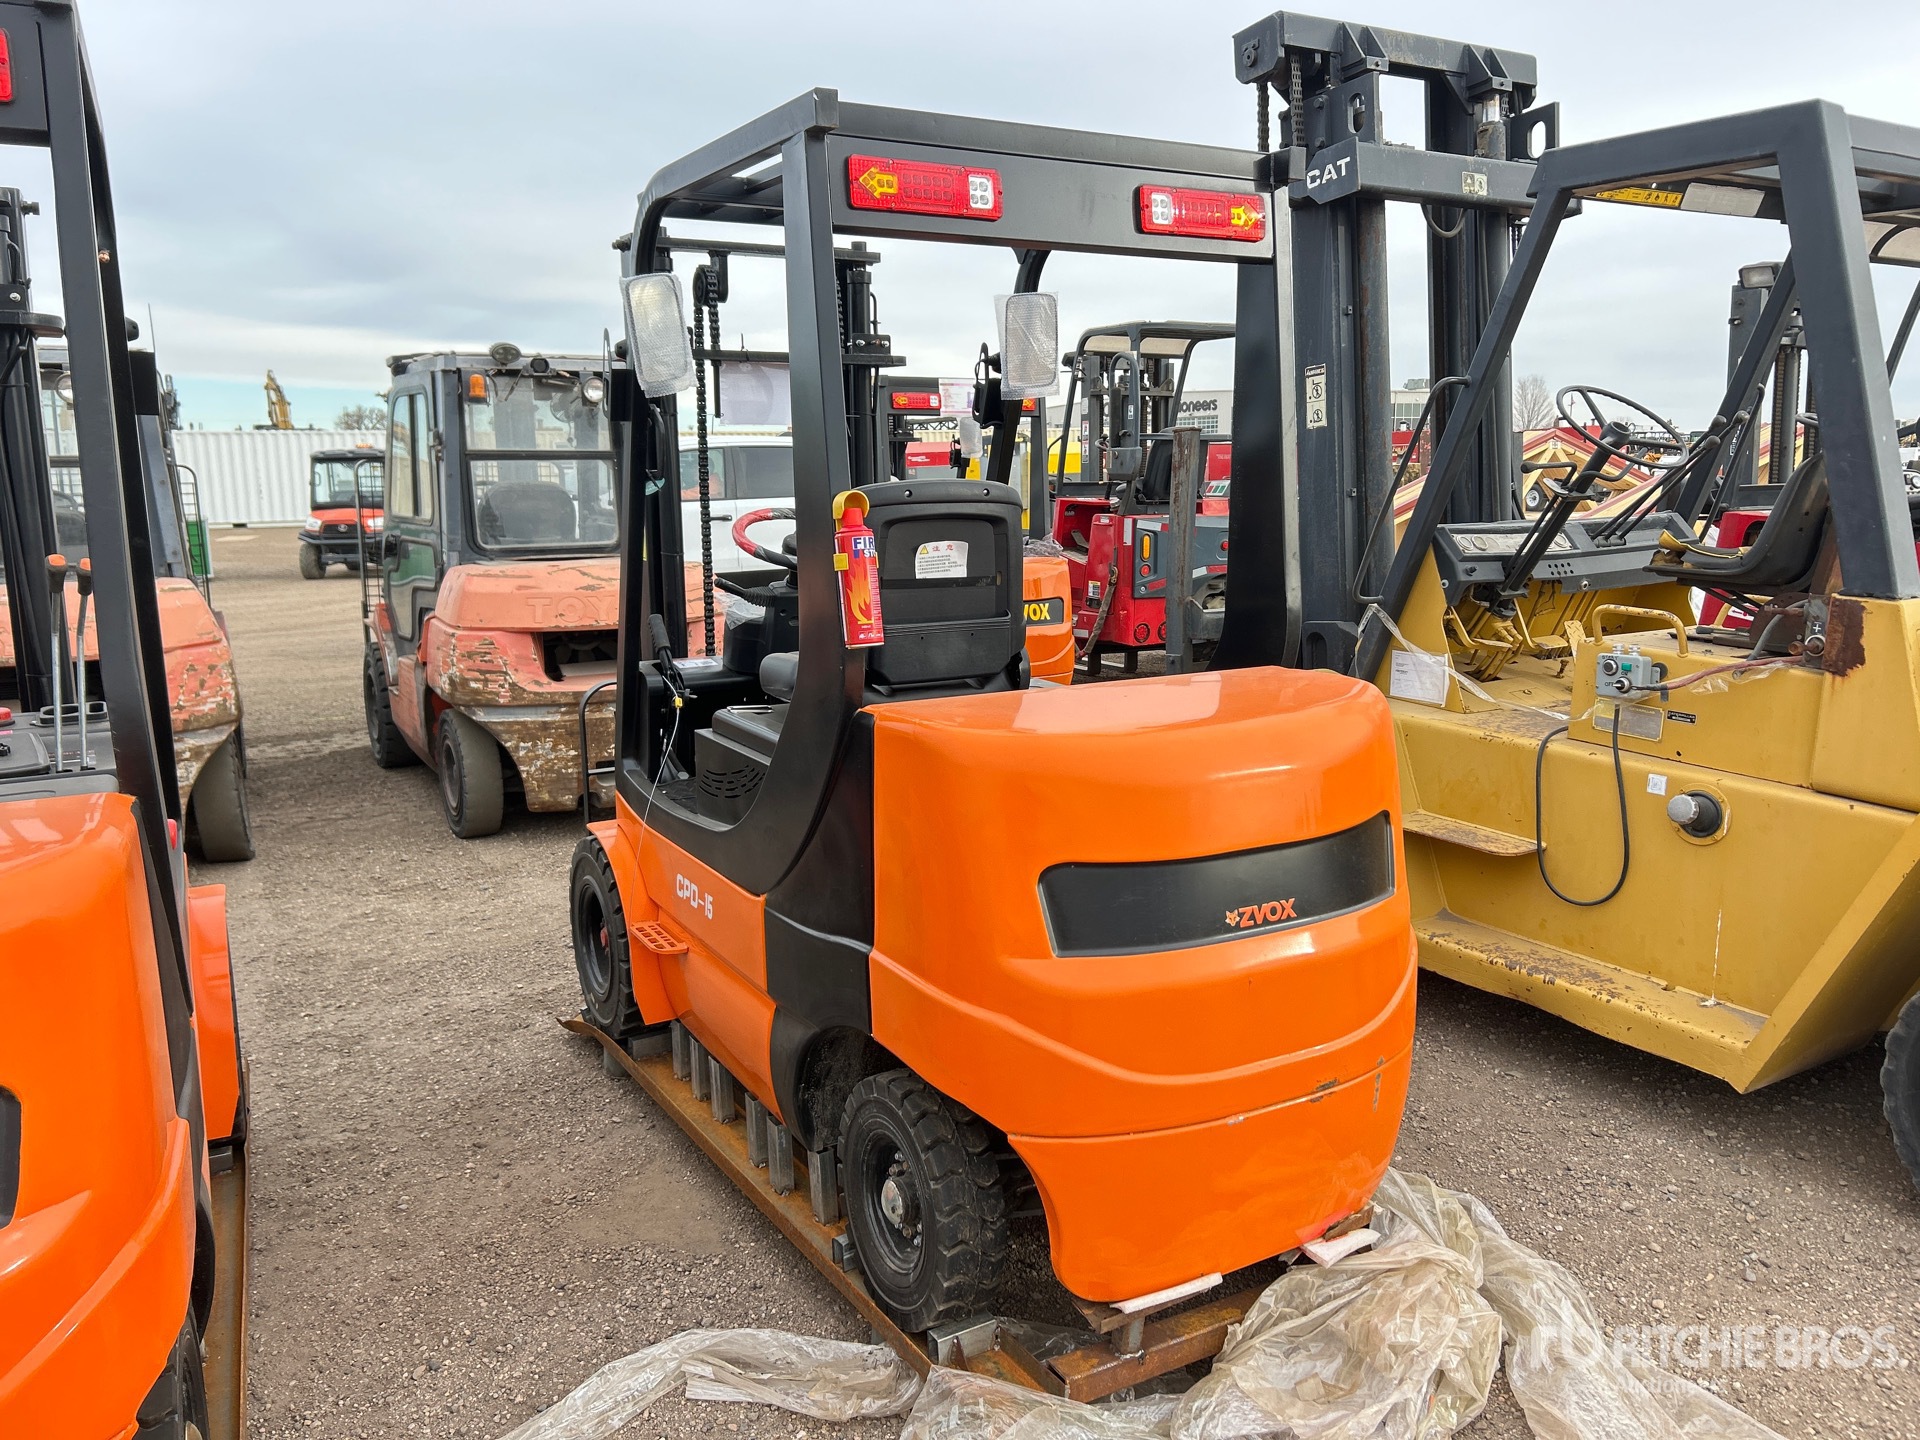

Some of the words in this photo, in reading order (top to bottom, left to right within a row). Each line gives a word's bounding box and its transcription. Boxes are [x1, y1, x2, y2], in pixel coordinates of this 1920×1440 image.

[1307, 157, 1351, 189] CAT
[526, 596, 617, 624] TOY
[676, 873, 713, 920] CPD-15
[1239, 898, 1297, 928] ZVOX
